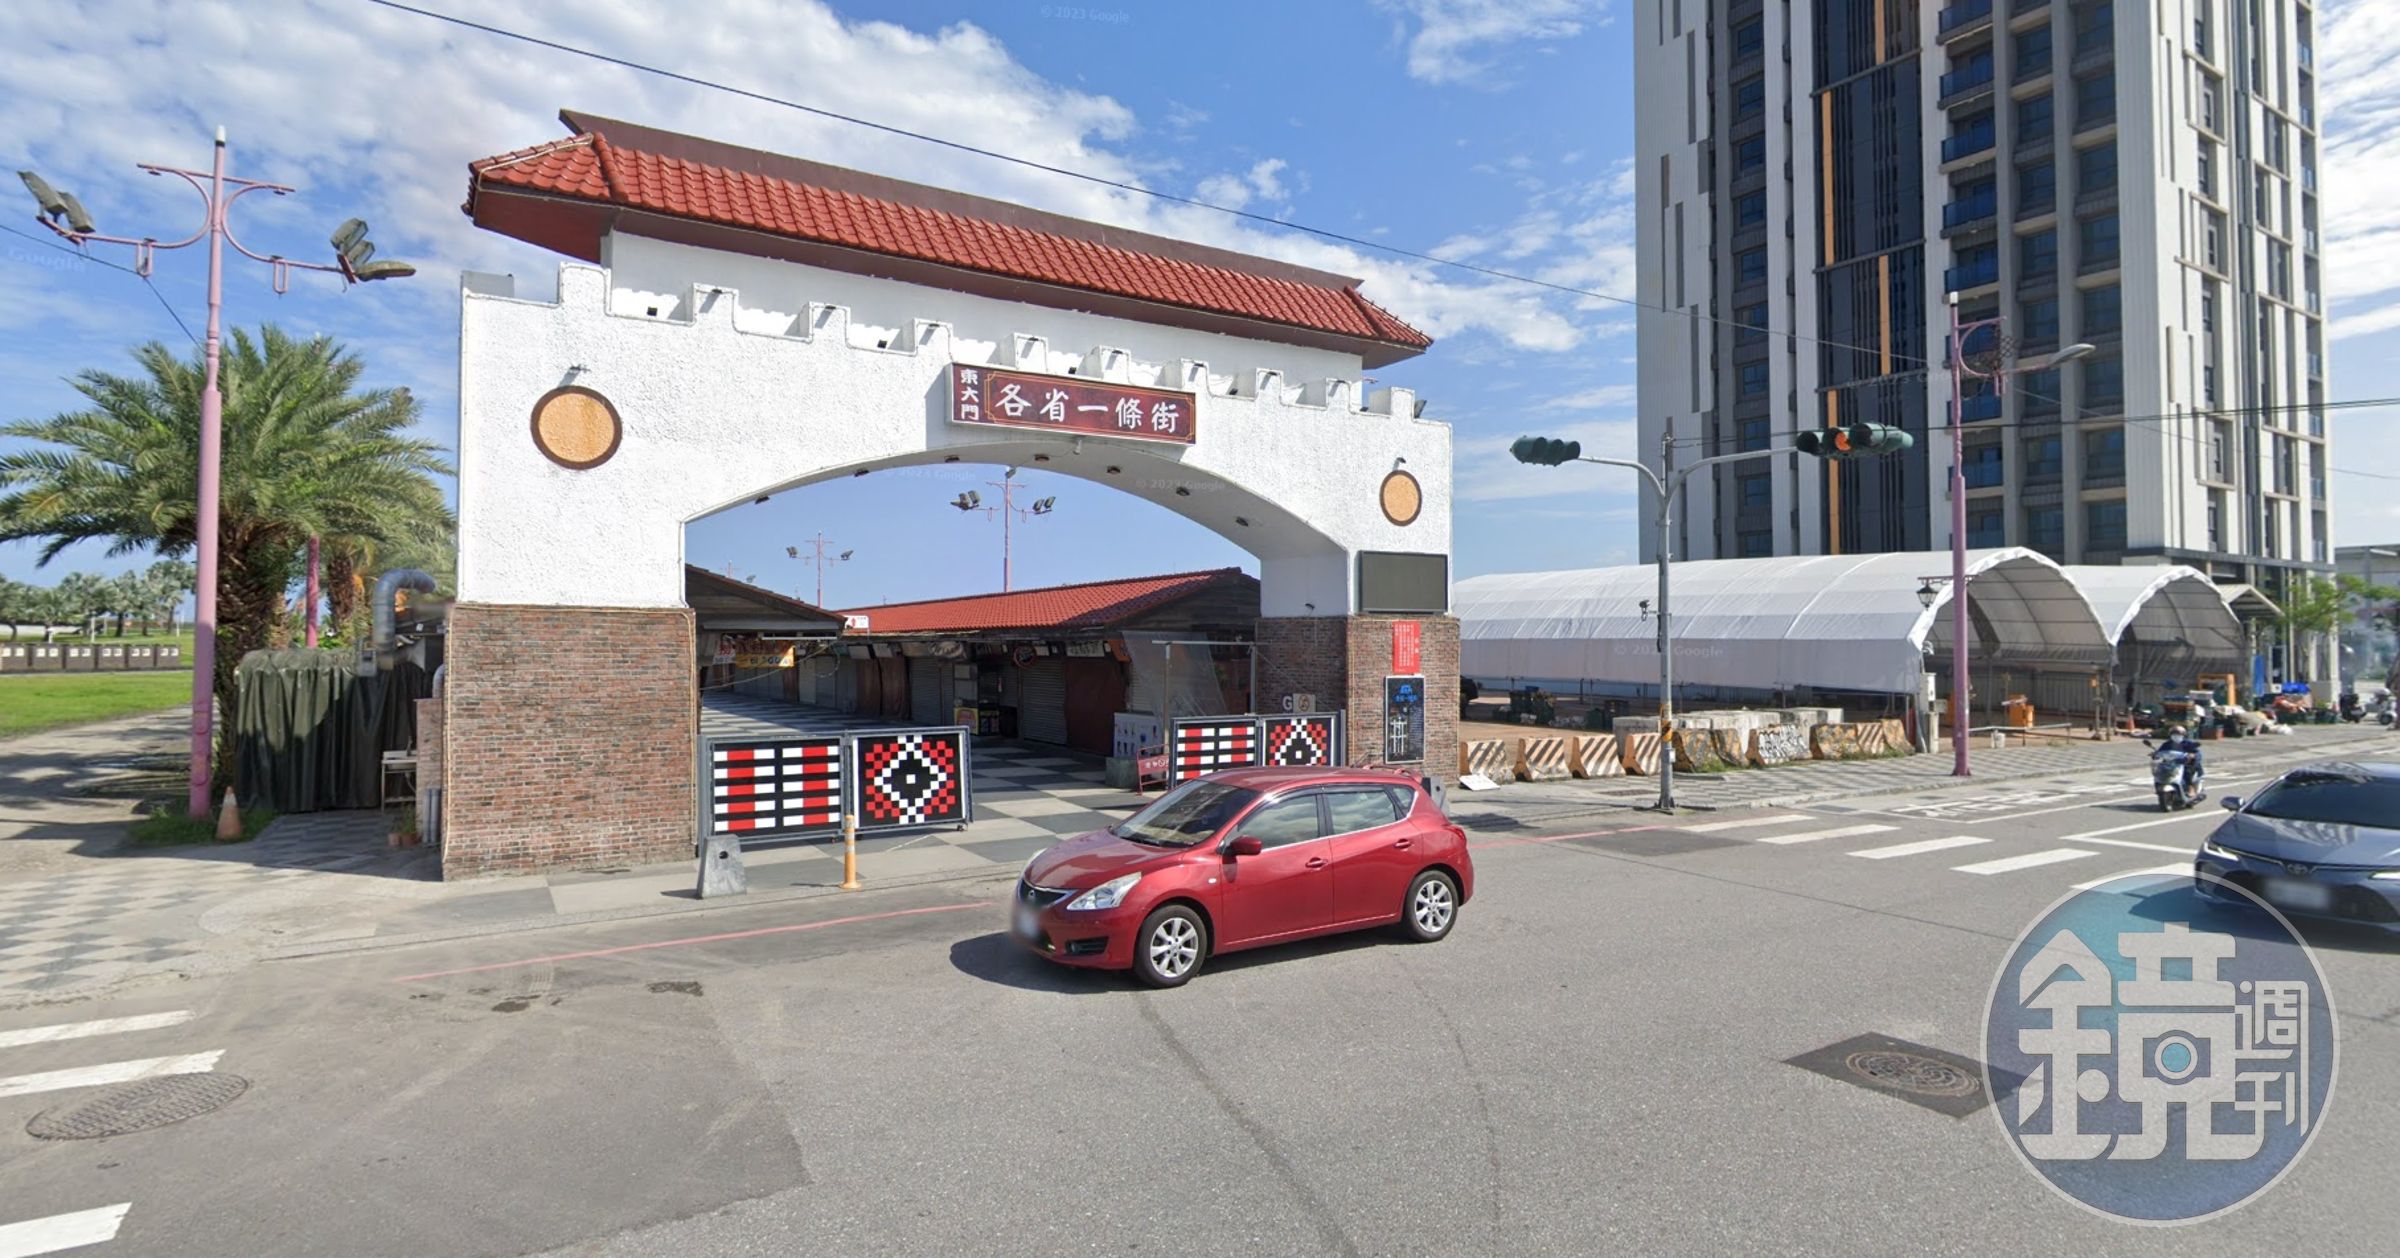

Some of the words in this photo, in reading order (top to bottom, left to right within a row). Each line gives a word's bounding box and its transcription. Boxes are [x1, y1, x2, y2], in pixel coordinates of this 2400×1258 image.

[959, 368, 980, 421] 東大門
[994, 383, 1180, 434] 各省一條街
[1282, 695, 1294, 711] G
